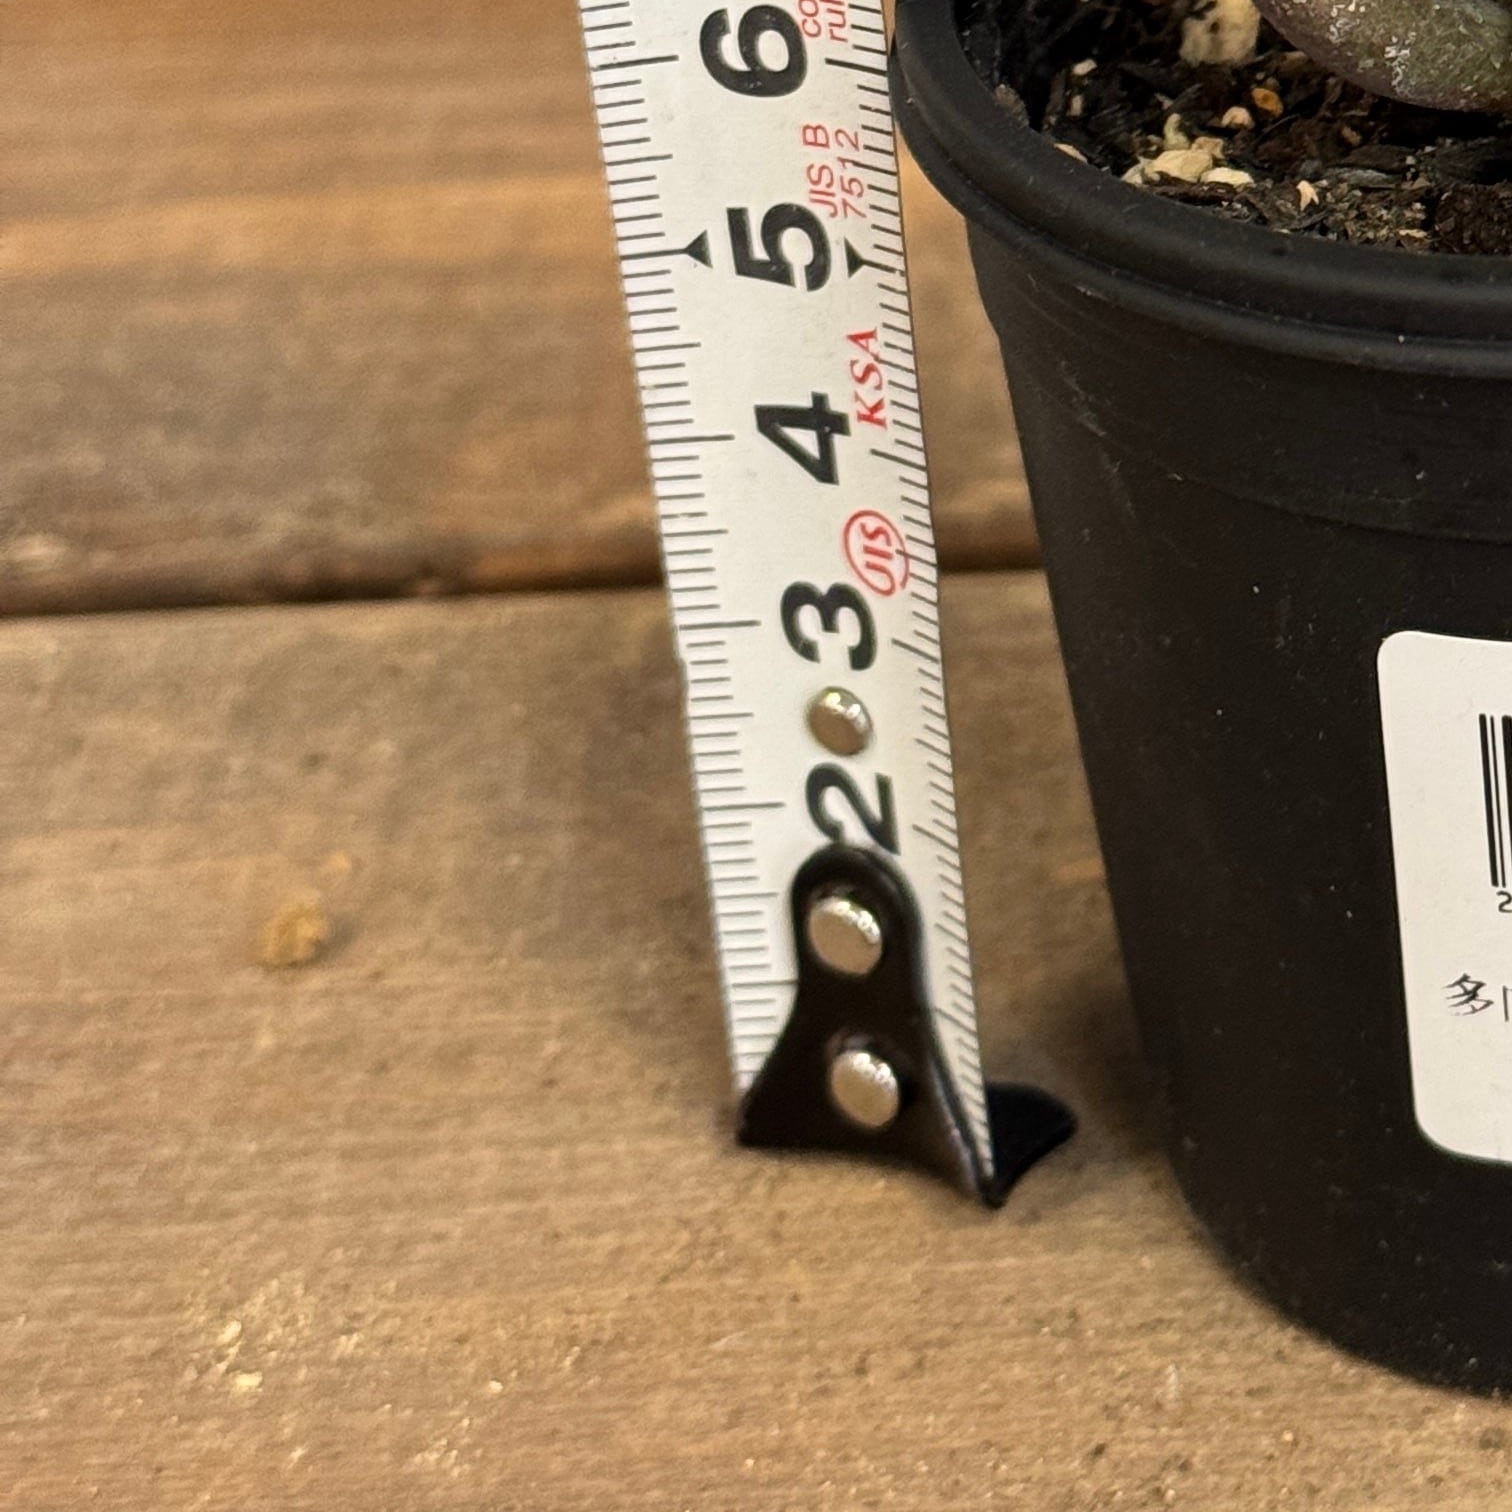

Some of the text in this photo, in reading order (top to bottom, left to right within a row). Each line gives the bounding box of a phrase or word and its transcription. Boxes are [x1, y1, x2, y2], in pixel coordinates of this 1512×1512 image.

[700, 4, 808, 98] 6
[806, 164, 838, 218] JIS
[834, 128, 868, 219] 7512
[726, 202, 832, 292] 5
[846, 327, 889, 430] KSA
[754, 391, 851, 486] 4
[780, 580, 878, 672] 3
[805, 762, 901, 856] 2
